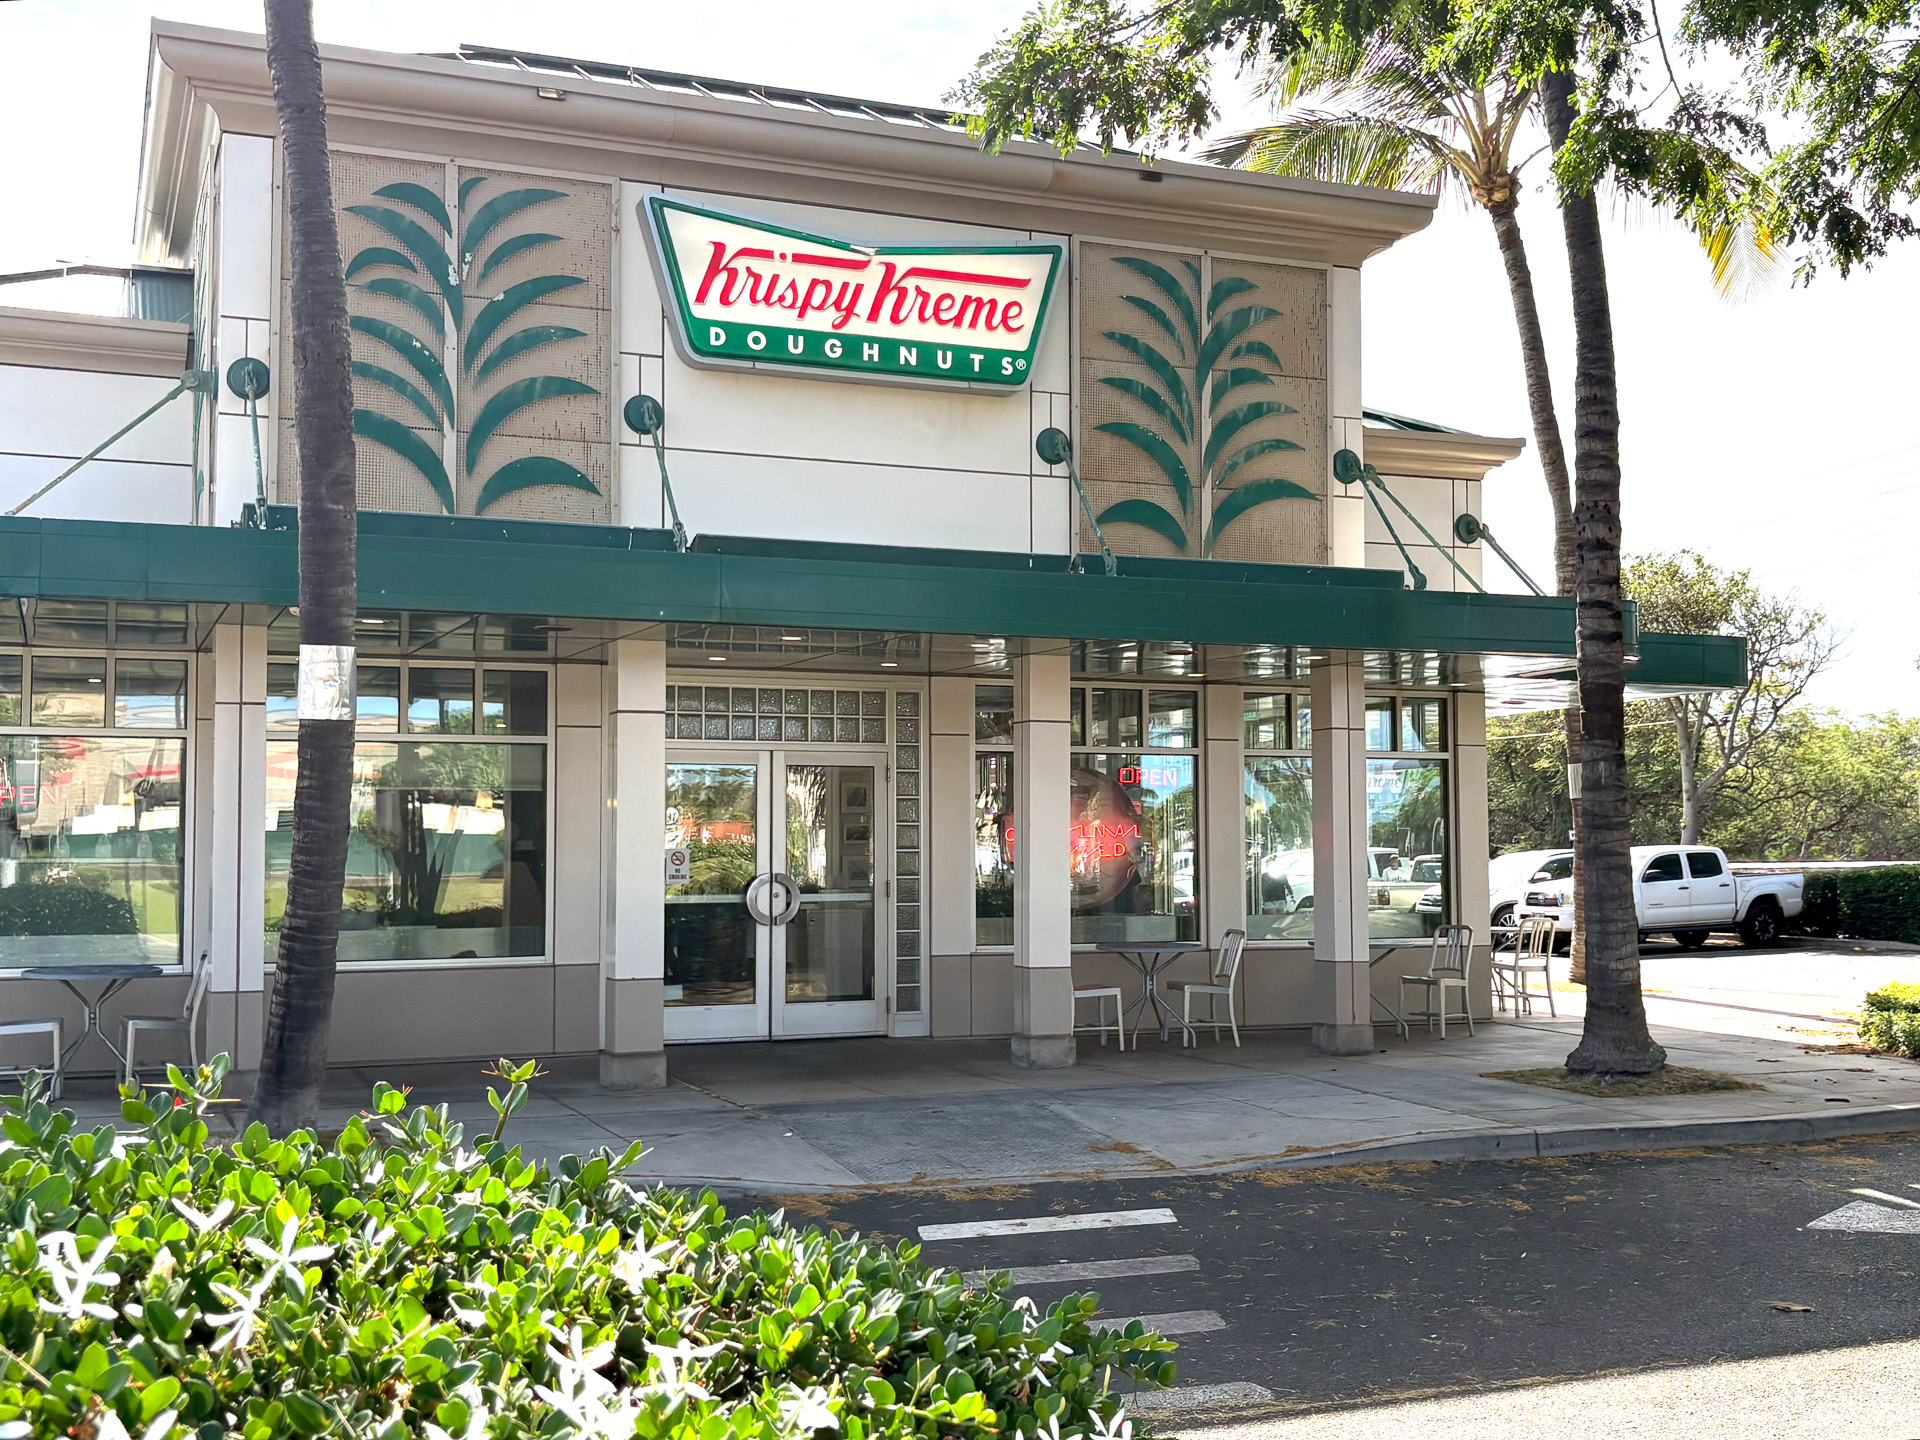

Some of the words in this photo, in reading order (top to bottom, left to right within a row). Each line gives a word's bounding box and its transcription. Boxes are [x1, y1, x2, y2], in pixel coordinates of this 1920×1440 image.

[694, 240, 871, 331] Krispy
[866, 261, 1032, 334] Kreme
[1119, 767, 1177, 787] OPEN
[0, 785, 61, 806] PEN
